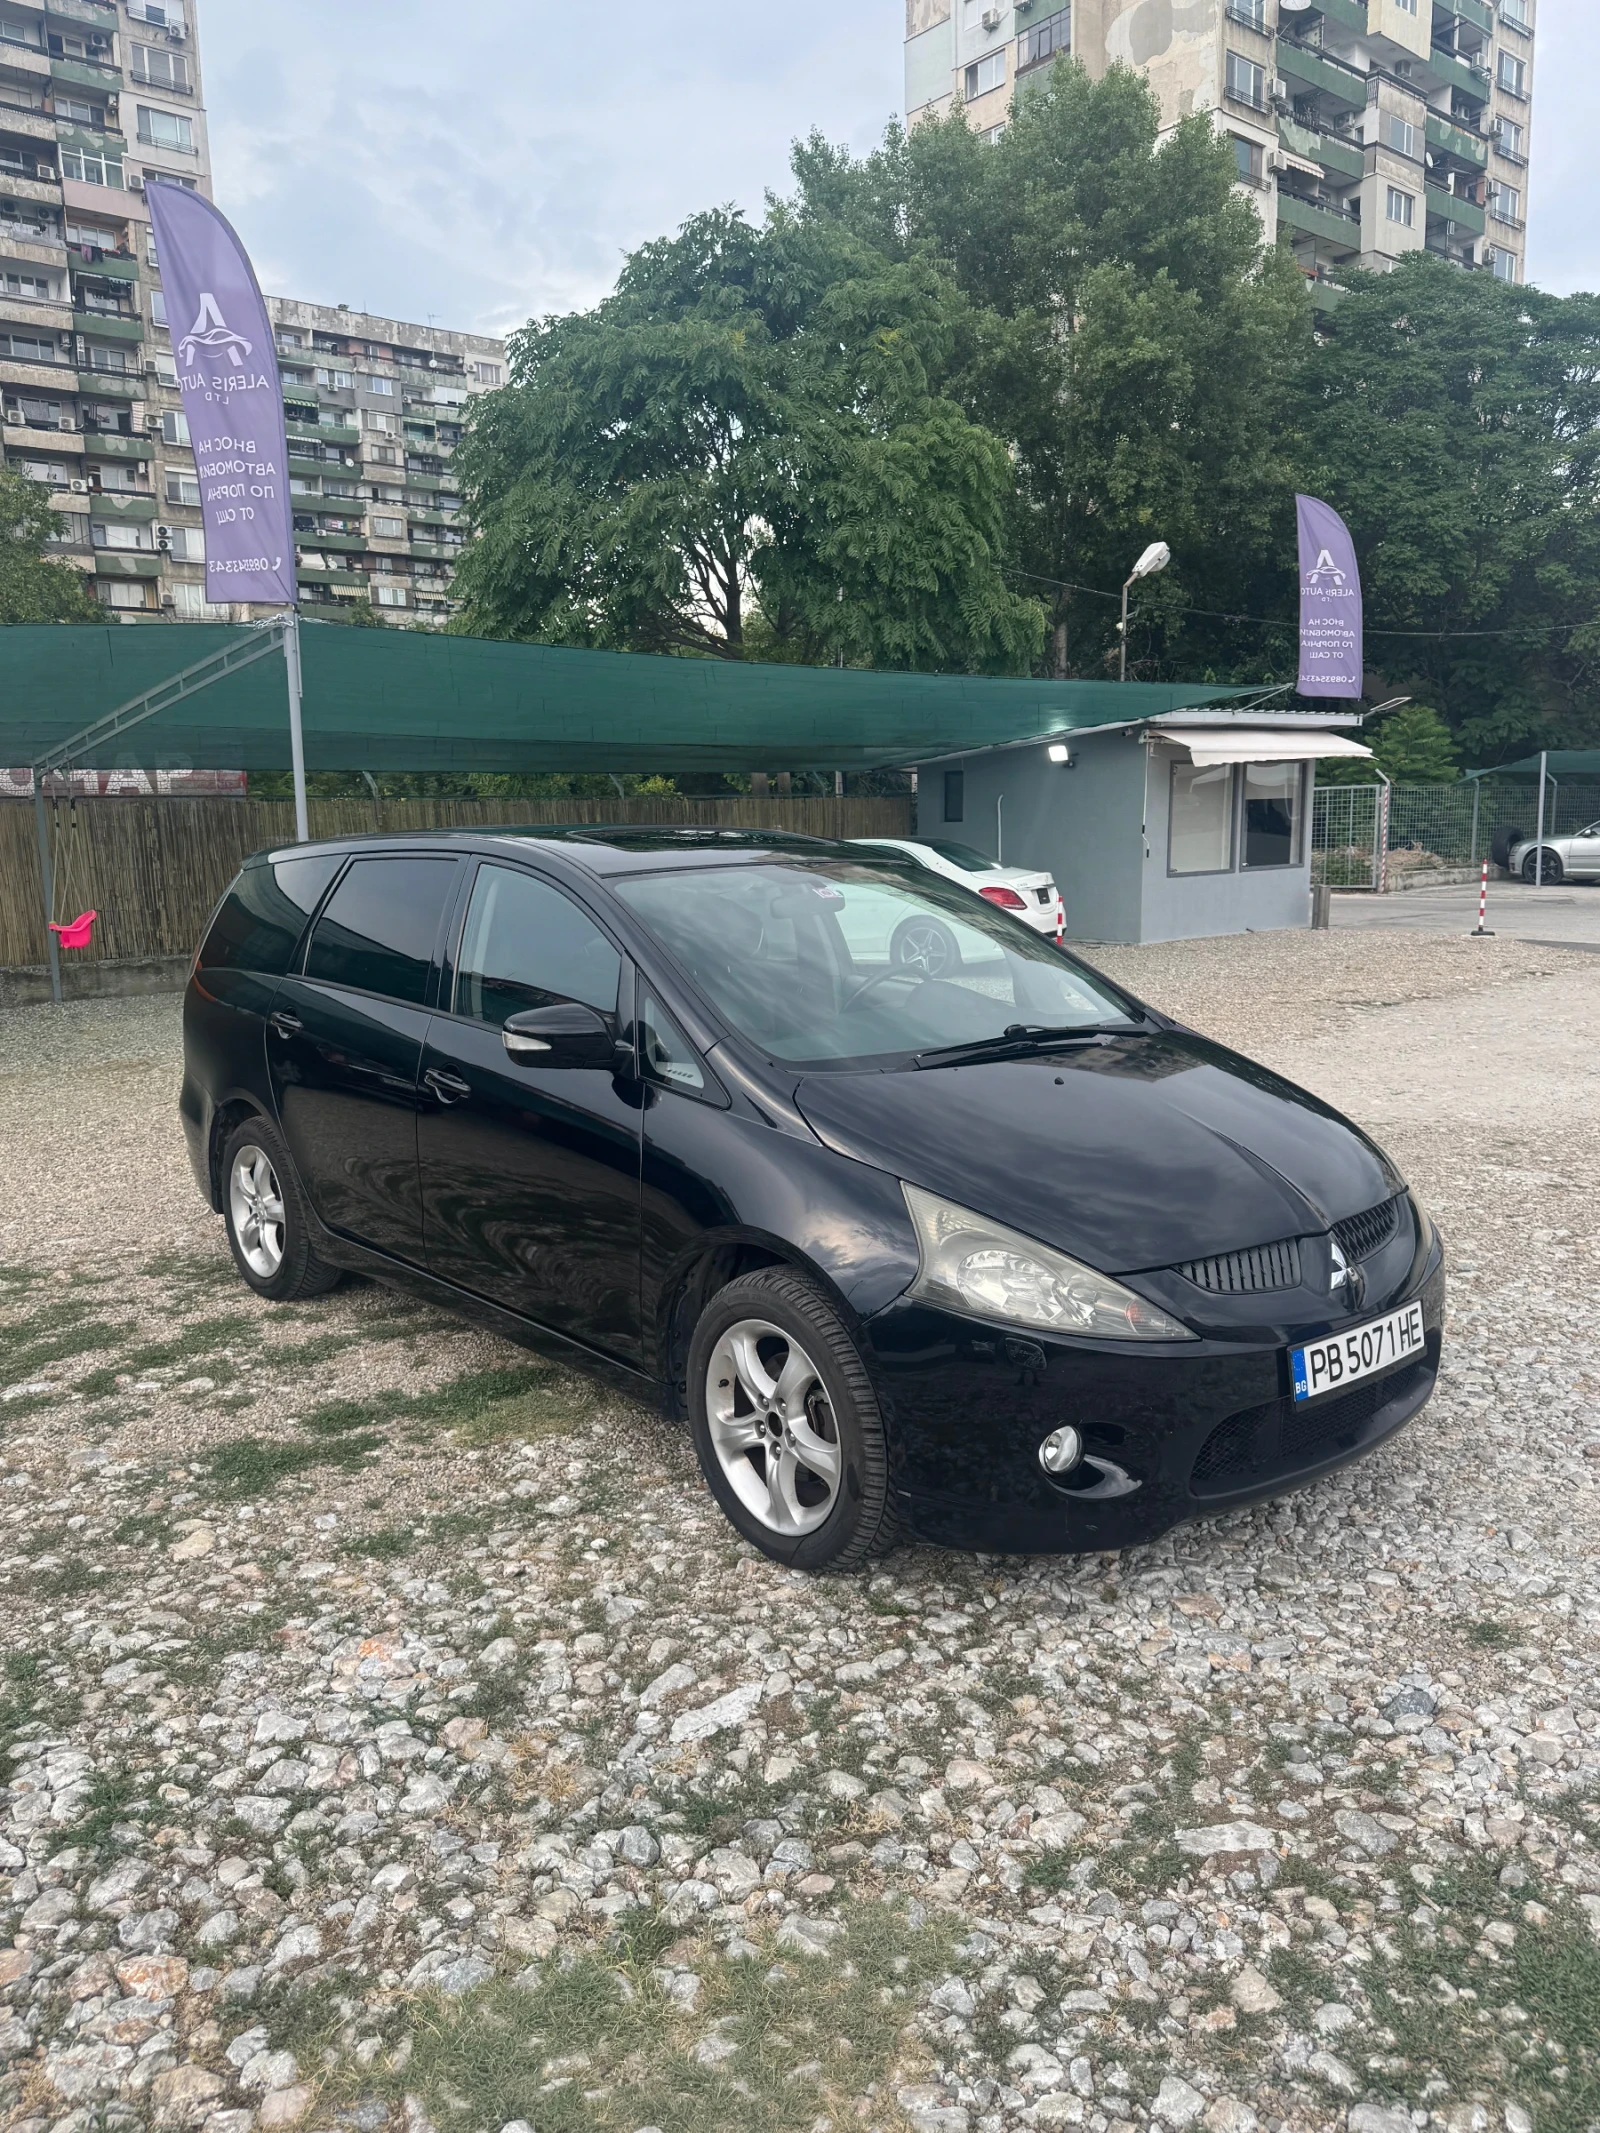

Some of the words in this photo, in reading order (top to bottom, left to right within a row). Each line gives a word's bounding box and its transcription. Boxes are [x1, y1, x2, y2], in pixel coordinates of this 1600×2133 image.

[1309, 1343, 1343, 1389] PB
[1346, 1320, 1396, 1374] 5071
[1397, 1307, 1422, 1352] HE
[1294, 1380, 1307, 1394] BG
